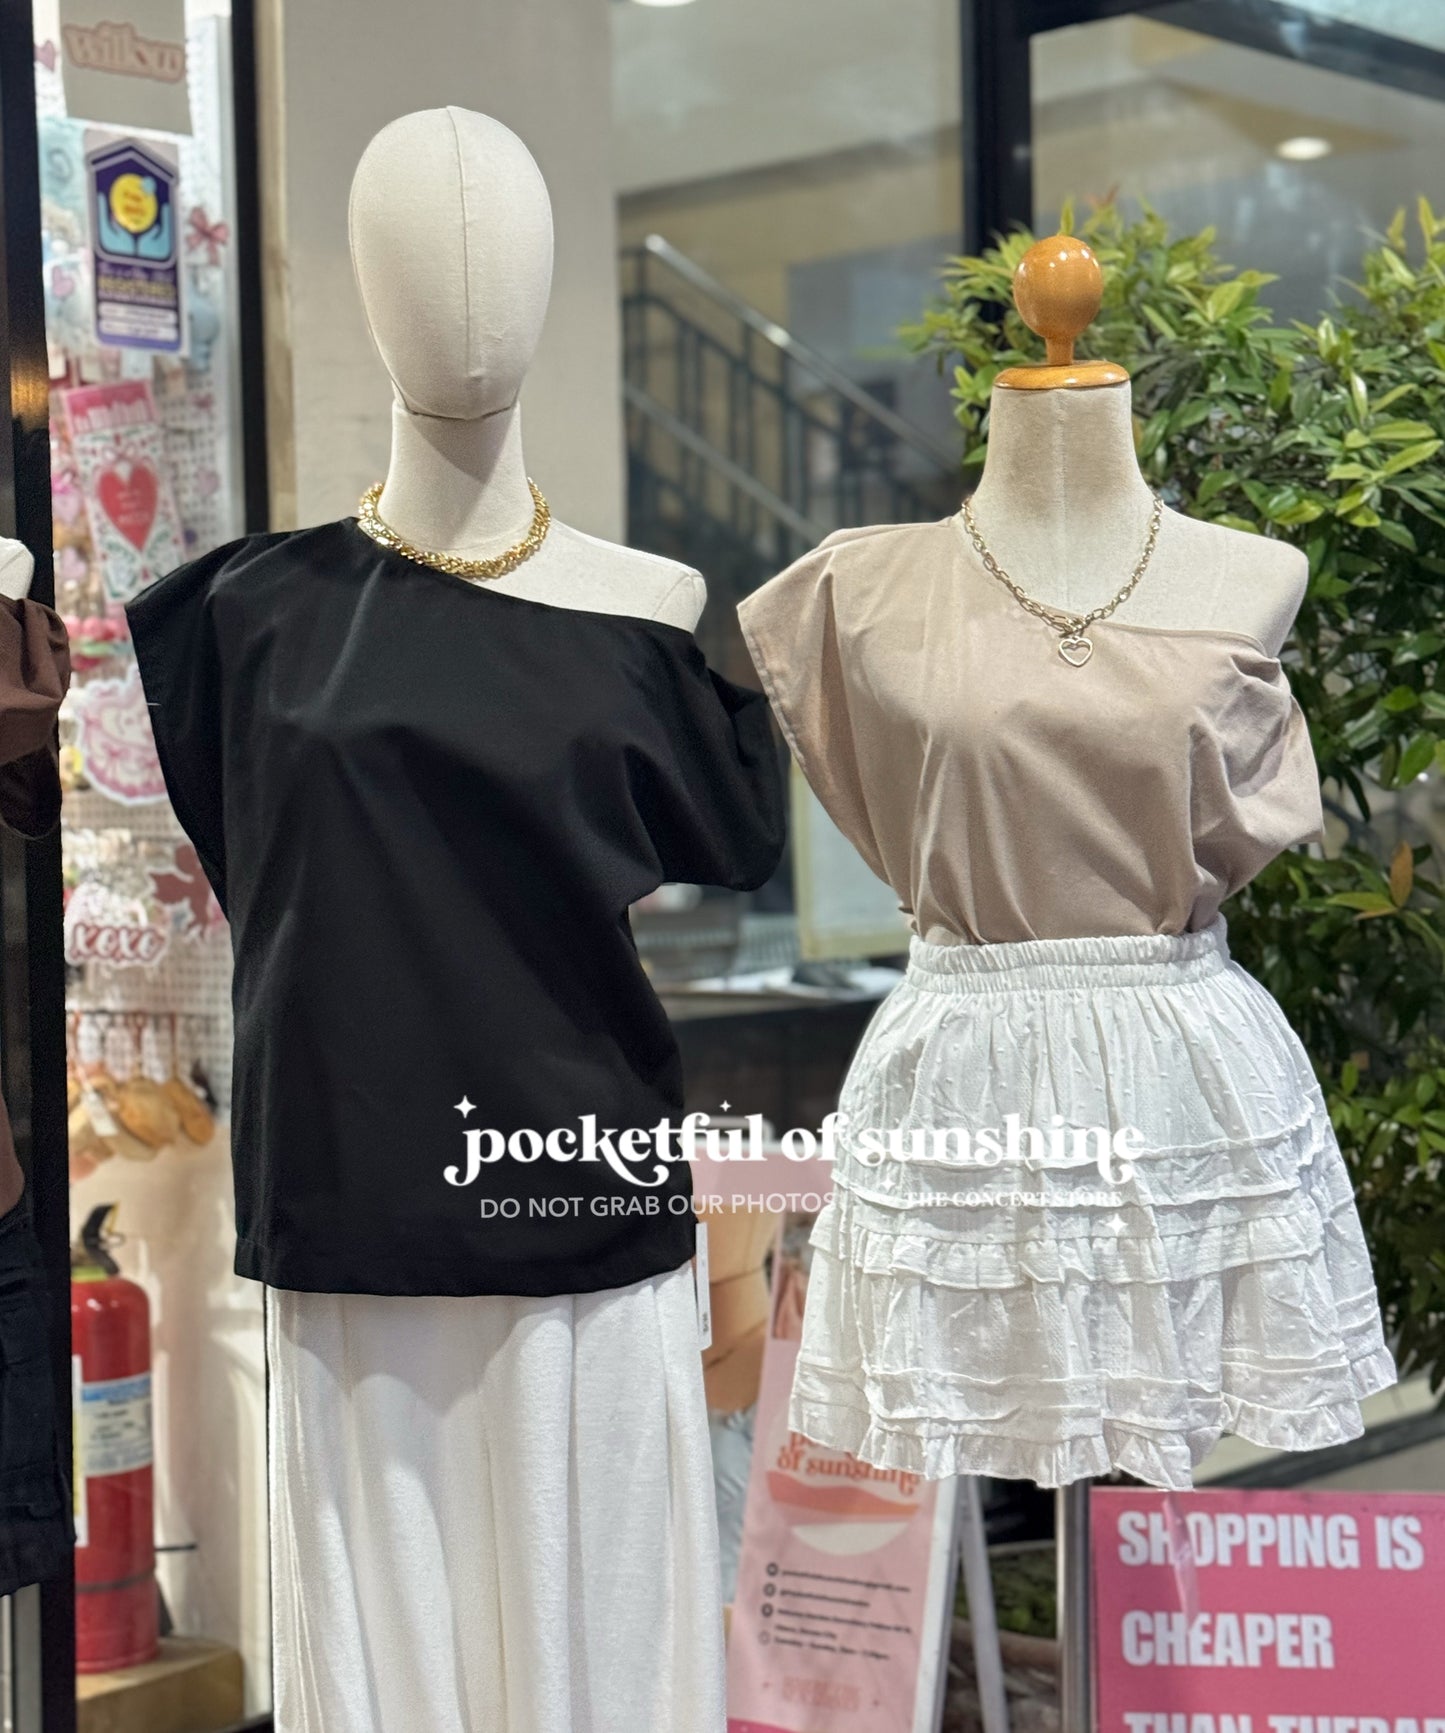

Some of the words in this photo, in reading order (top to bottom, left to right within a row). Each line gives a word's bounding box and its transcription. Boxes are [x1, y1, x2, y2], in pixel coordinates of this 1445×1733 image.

[778, 1446, 803, 1470] of
[1117, 1511, 1361, 1569] SHOPPING
[1375, 1514, 1425, 1571] IS
[1121, 1610, 1335, 1669] CHEAPER
